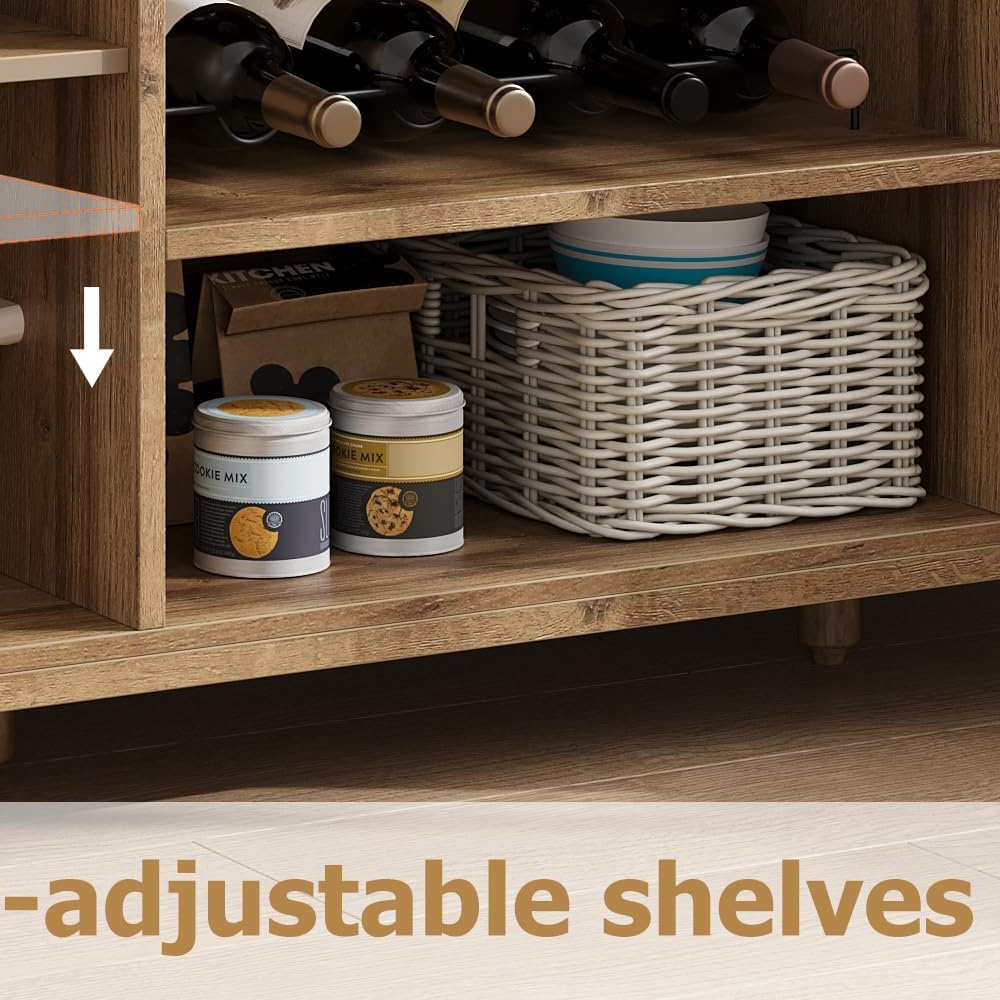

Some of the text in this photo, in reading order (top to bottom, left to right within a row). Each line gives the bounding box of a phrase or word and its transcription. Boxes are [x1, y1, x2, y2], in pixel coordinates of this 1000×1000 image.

[203, 261, 336, 285] KITCHEN
[360, 452, 384, 463] MIX
[193, 463, 248, 483] OOKIE MIX
